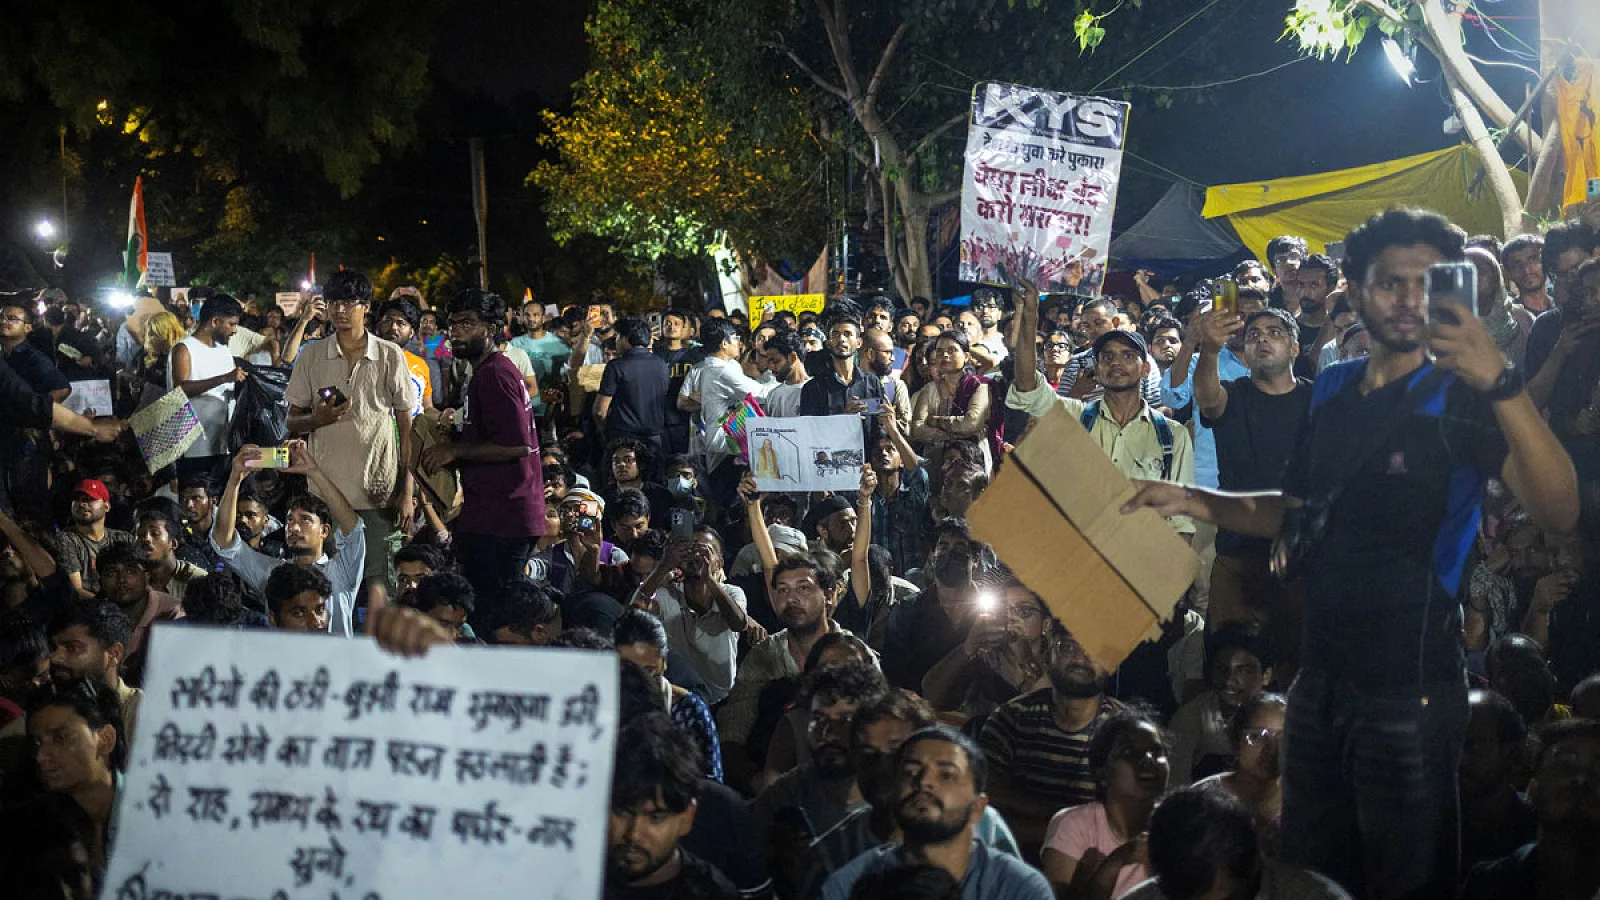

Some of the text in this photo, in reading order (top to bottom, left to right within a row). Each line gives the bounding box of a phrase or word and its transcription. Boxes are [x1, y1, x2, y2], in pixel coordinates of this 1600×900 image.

[982, 83, 1118, 137] KYS
[1019, 167, 1069, 200] लीक
[976, 194, 1017, 225] करो
[276, 736, 316, 766] का
